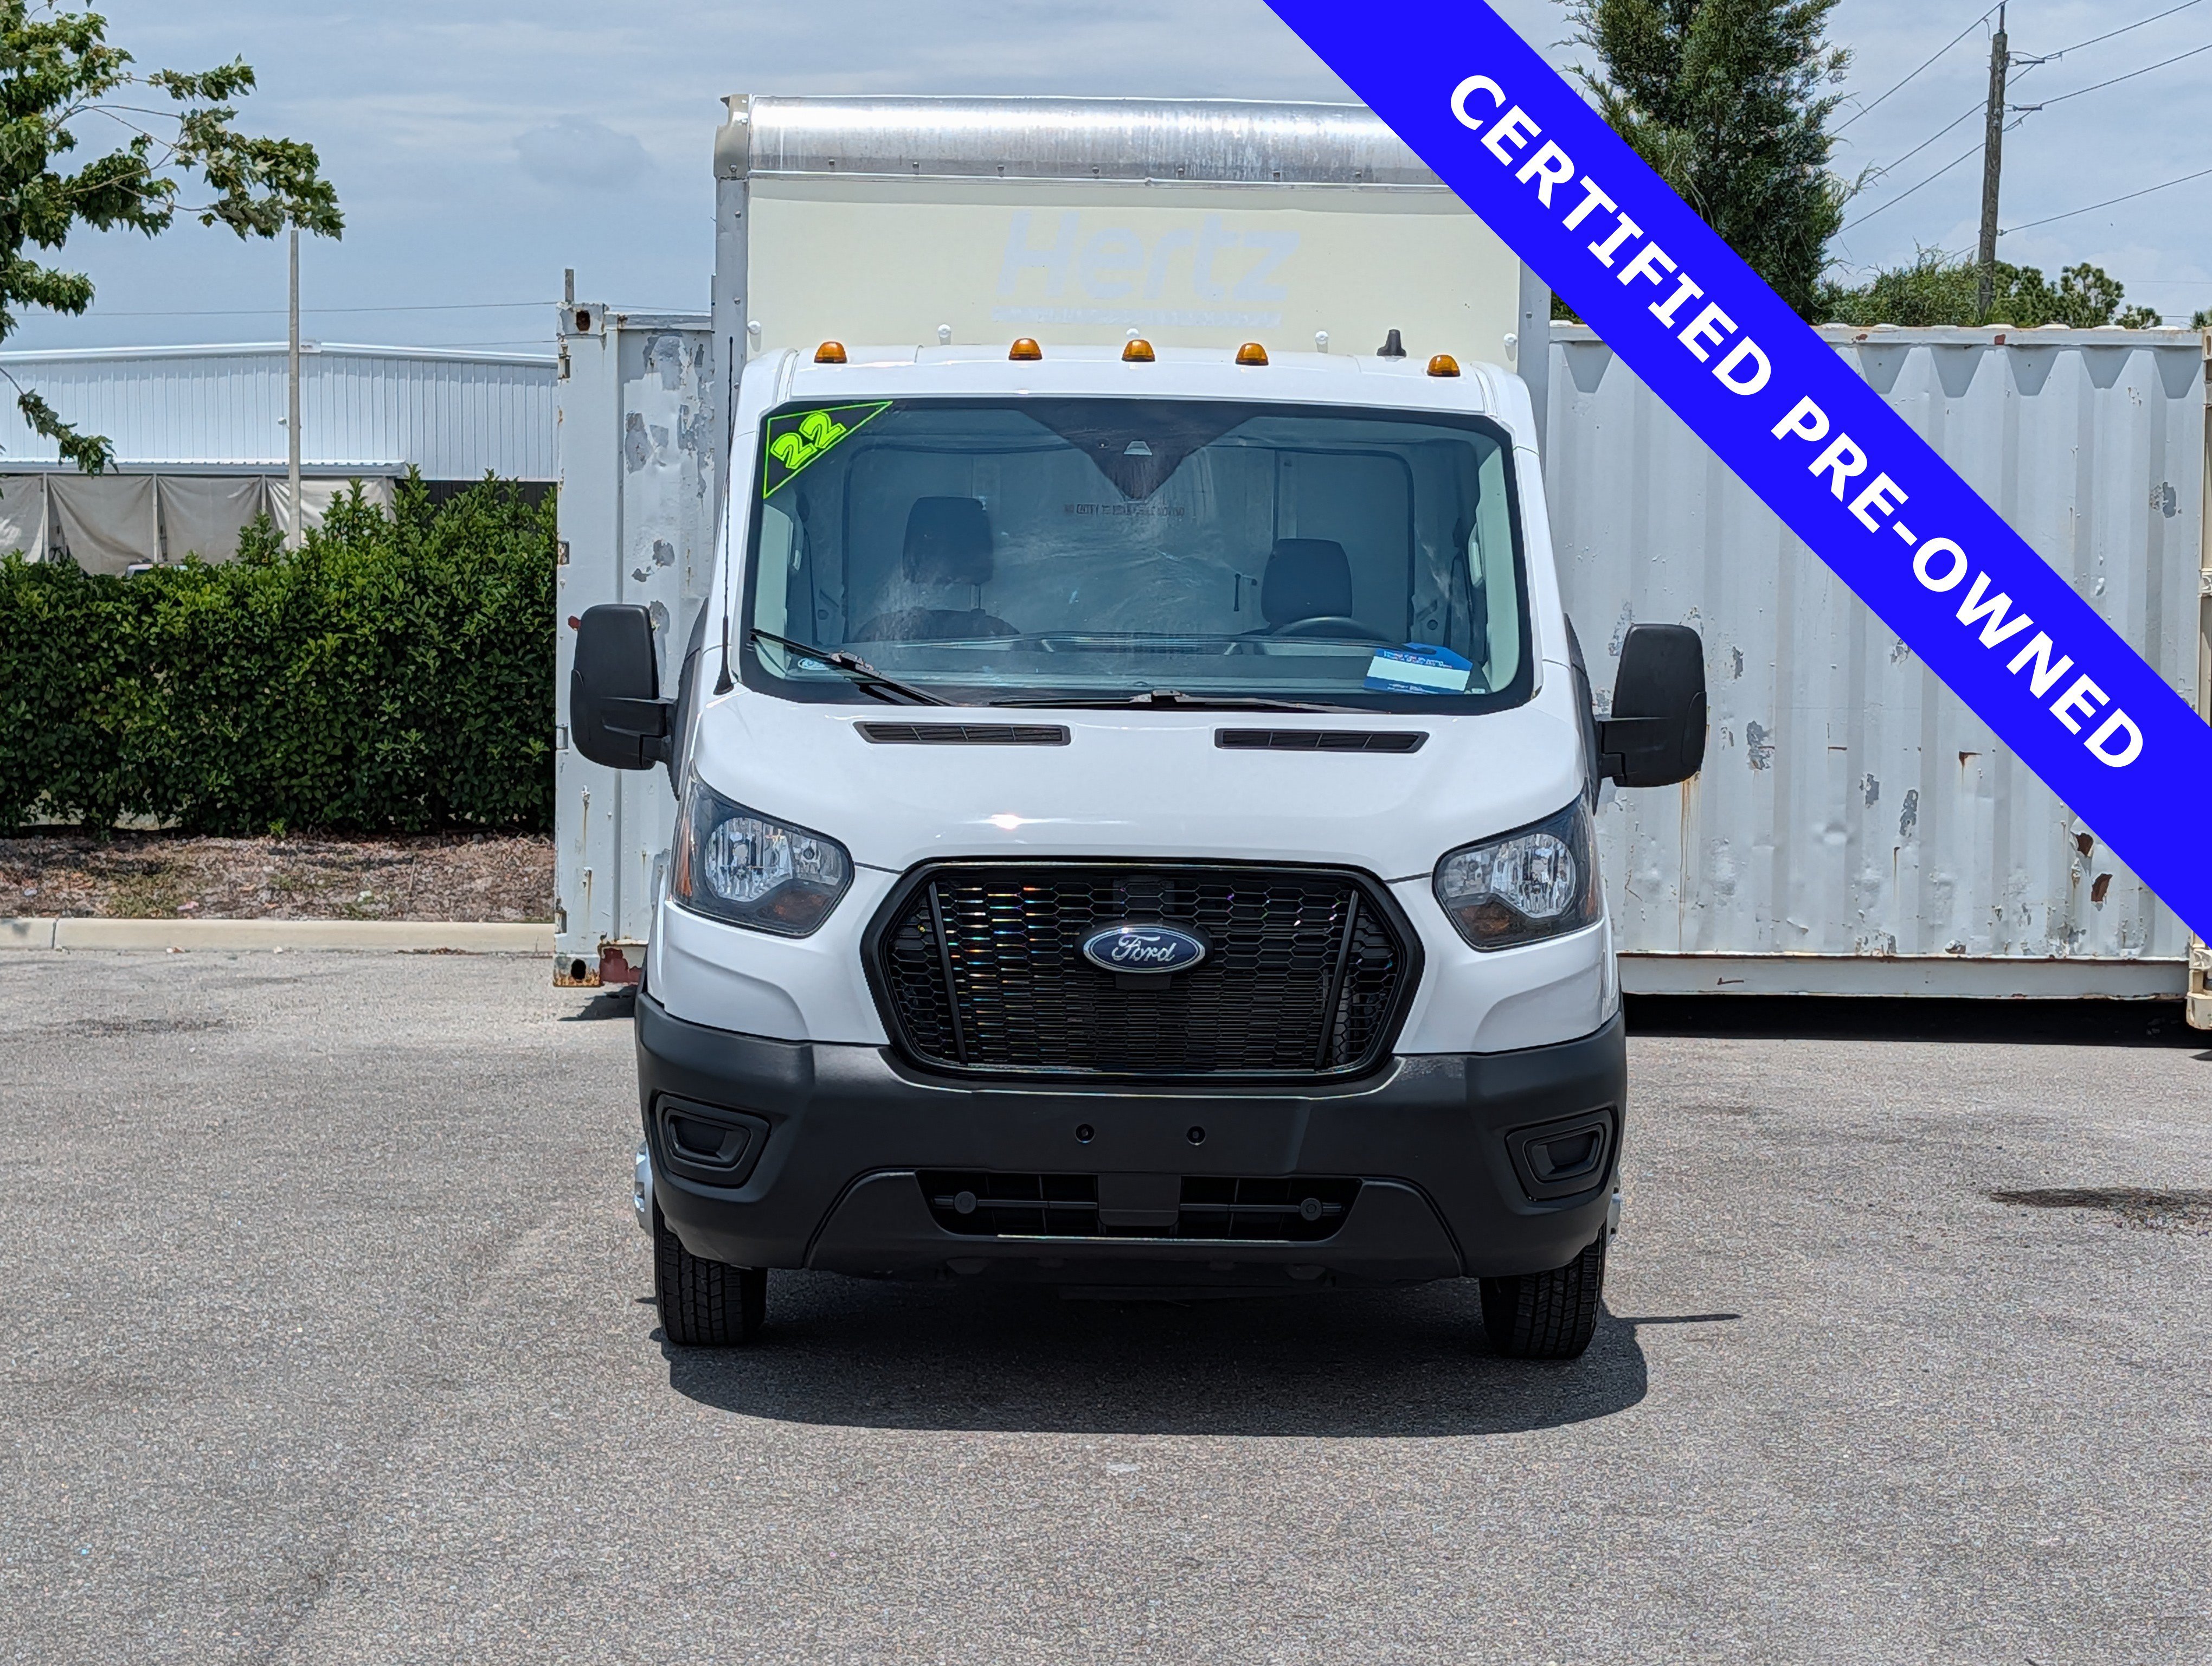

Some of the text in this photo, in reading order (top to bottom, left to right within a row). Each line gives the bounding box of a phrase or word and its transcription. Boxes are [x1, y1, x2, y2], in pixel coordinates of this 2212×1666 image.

[995, 210, 1300, 302] Hertz
[770, 411, 847, 470] 22
[1111, 934, 1175, 962] Ford
